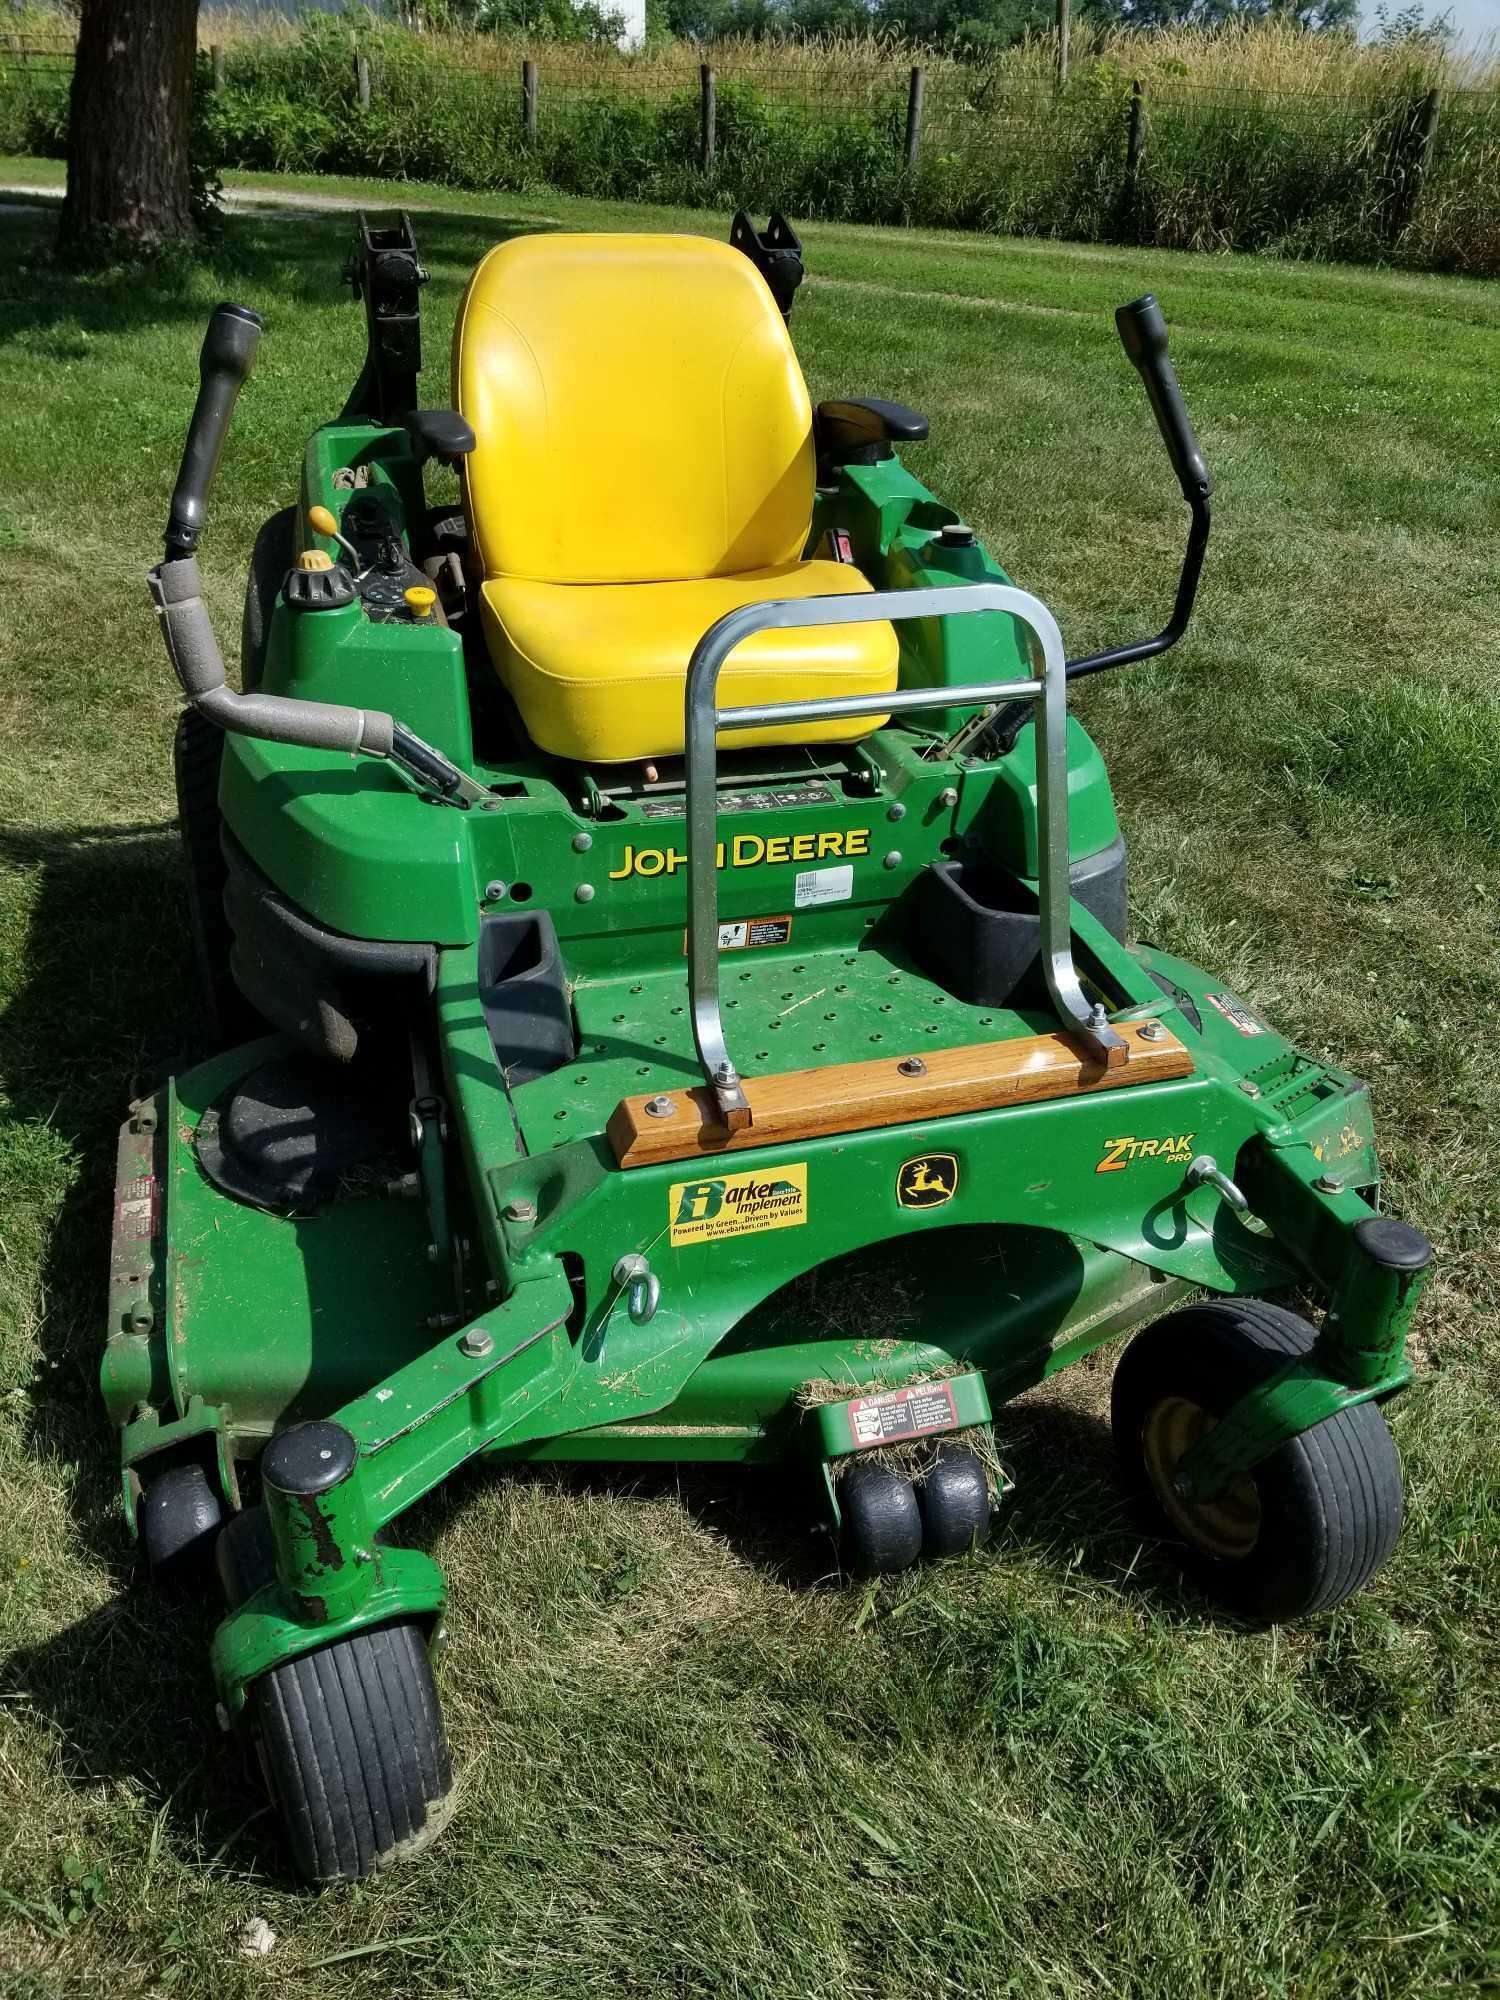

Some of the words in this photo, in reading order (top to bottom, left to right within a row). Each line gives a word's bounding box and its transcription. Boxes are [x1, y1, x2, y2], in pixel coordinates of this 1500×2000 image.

[732, 829, 871, 867] DEERE
[1165, 1152, 1193, 1164] PRO
[736, 1193, 803, 1215] Implement
[673, 1223, 704, 1236] Powered
[705, 1222, 714, 1231] by
[769, 1211, 779, 1220] by
[780, 1207, 804, 1217] Values
[706, 1221, 770, 1237] www.ebarkers.com
[868, 1394, 898, 1408] DANGER
